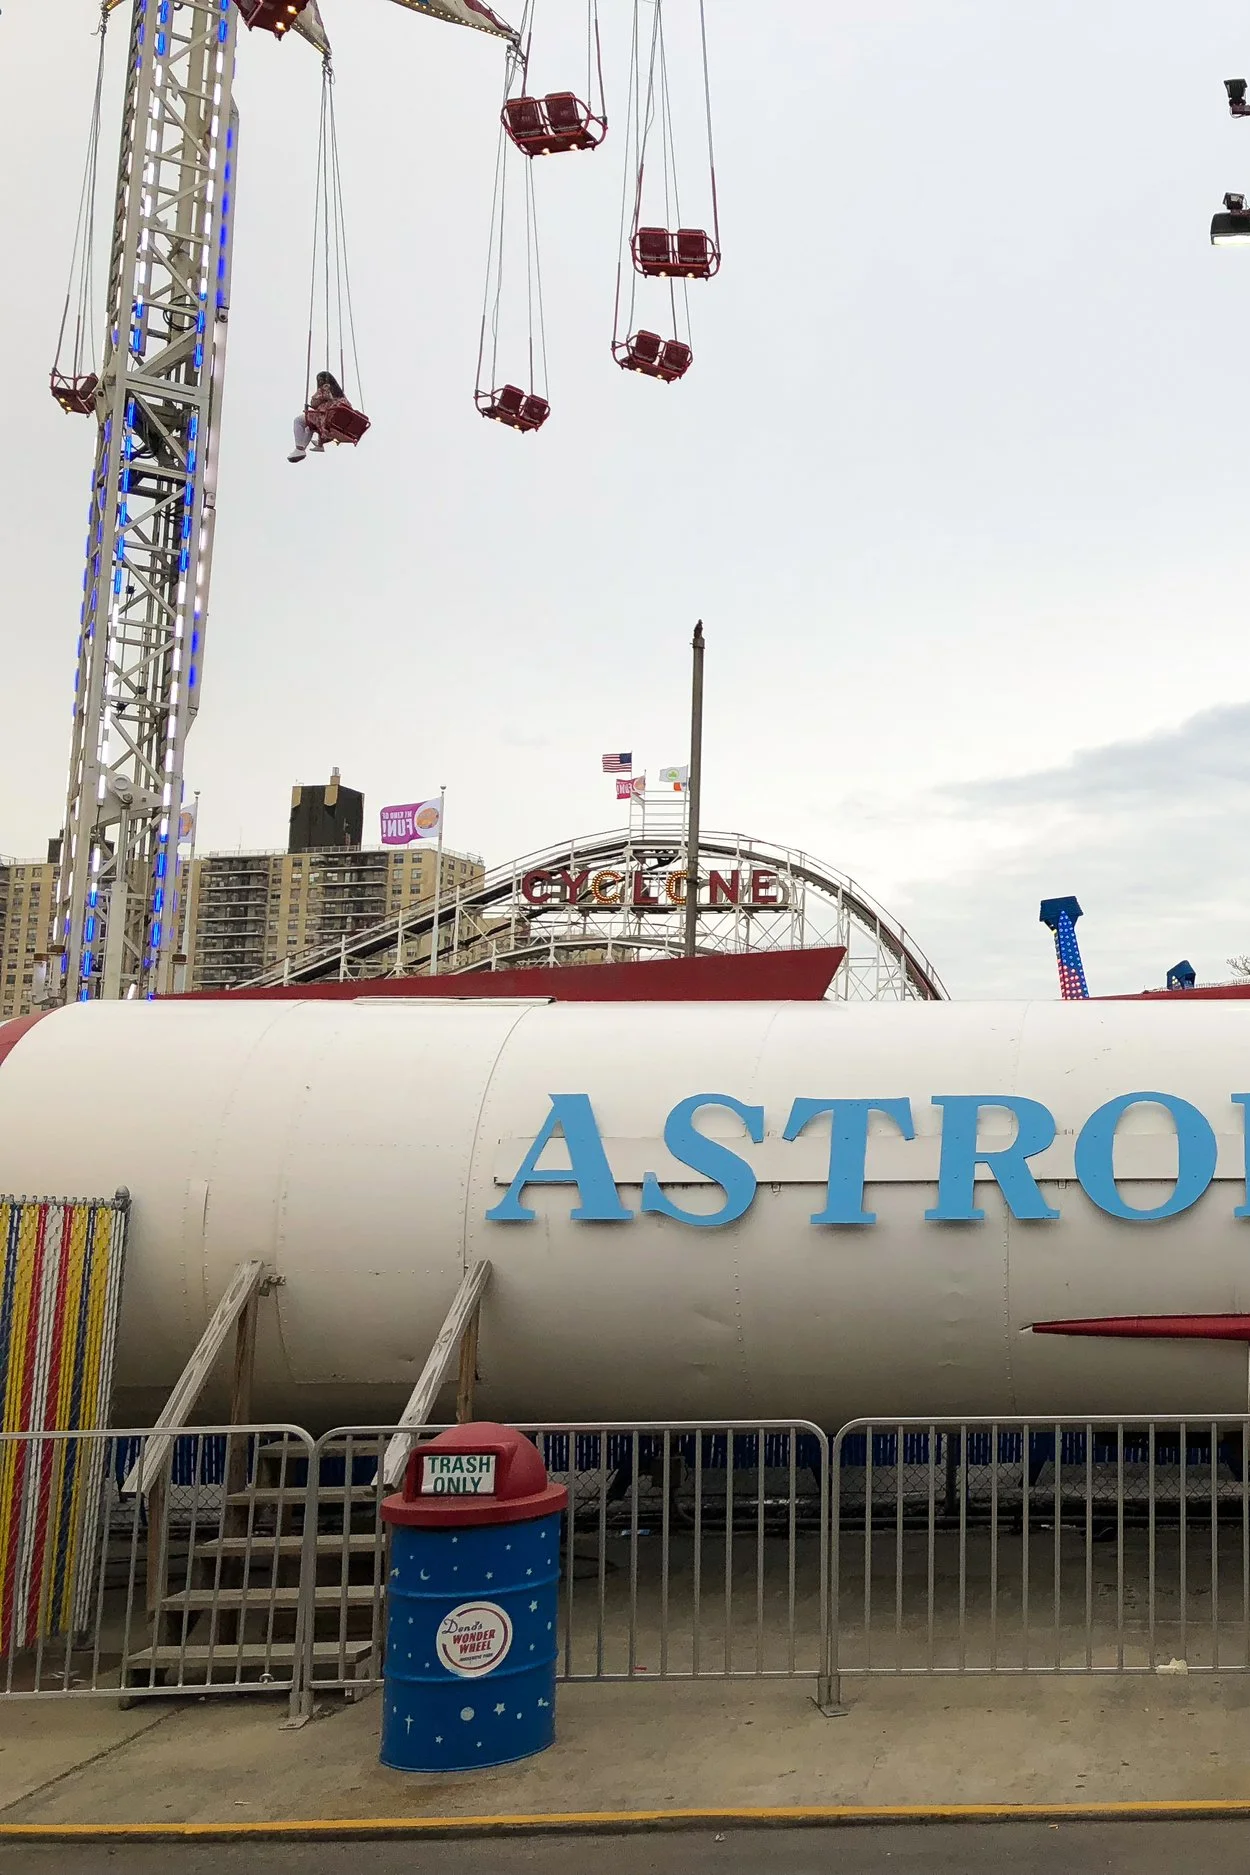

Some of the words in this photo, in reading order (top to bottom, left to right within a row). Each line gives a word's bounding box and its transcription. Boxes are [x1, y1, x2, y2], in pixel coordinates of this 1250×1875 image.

[428, 1456, 491, 1474] TRASH
[433, 1476, 482, 1493] ONLY
[442, 1618, 483, 1634] Deno's
[453, 1629, 496, 1645] WONDER
[459, 1640, 491, 1654] WHEEL
